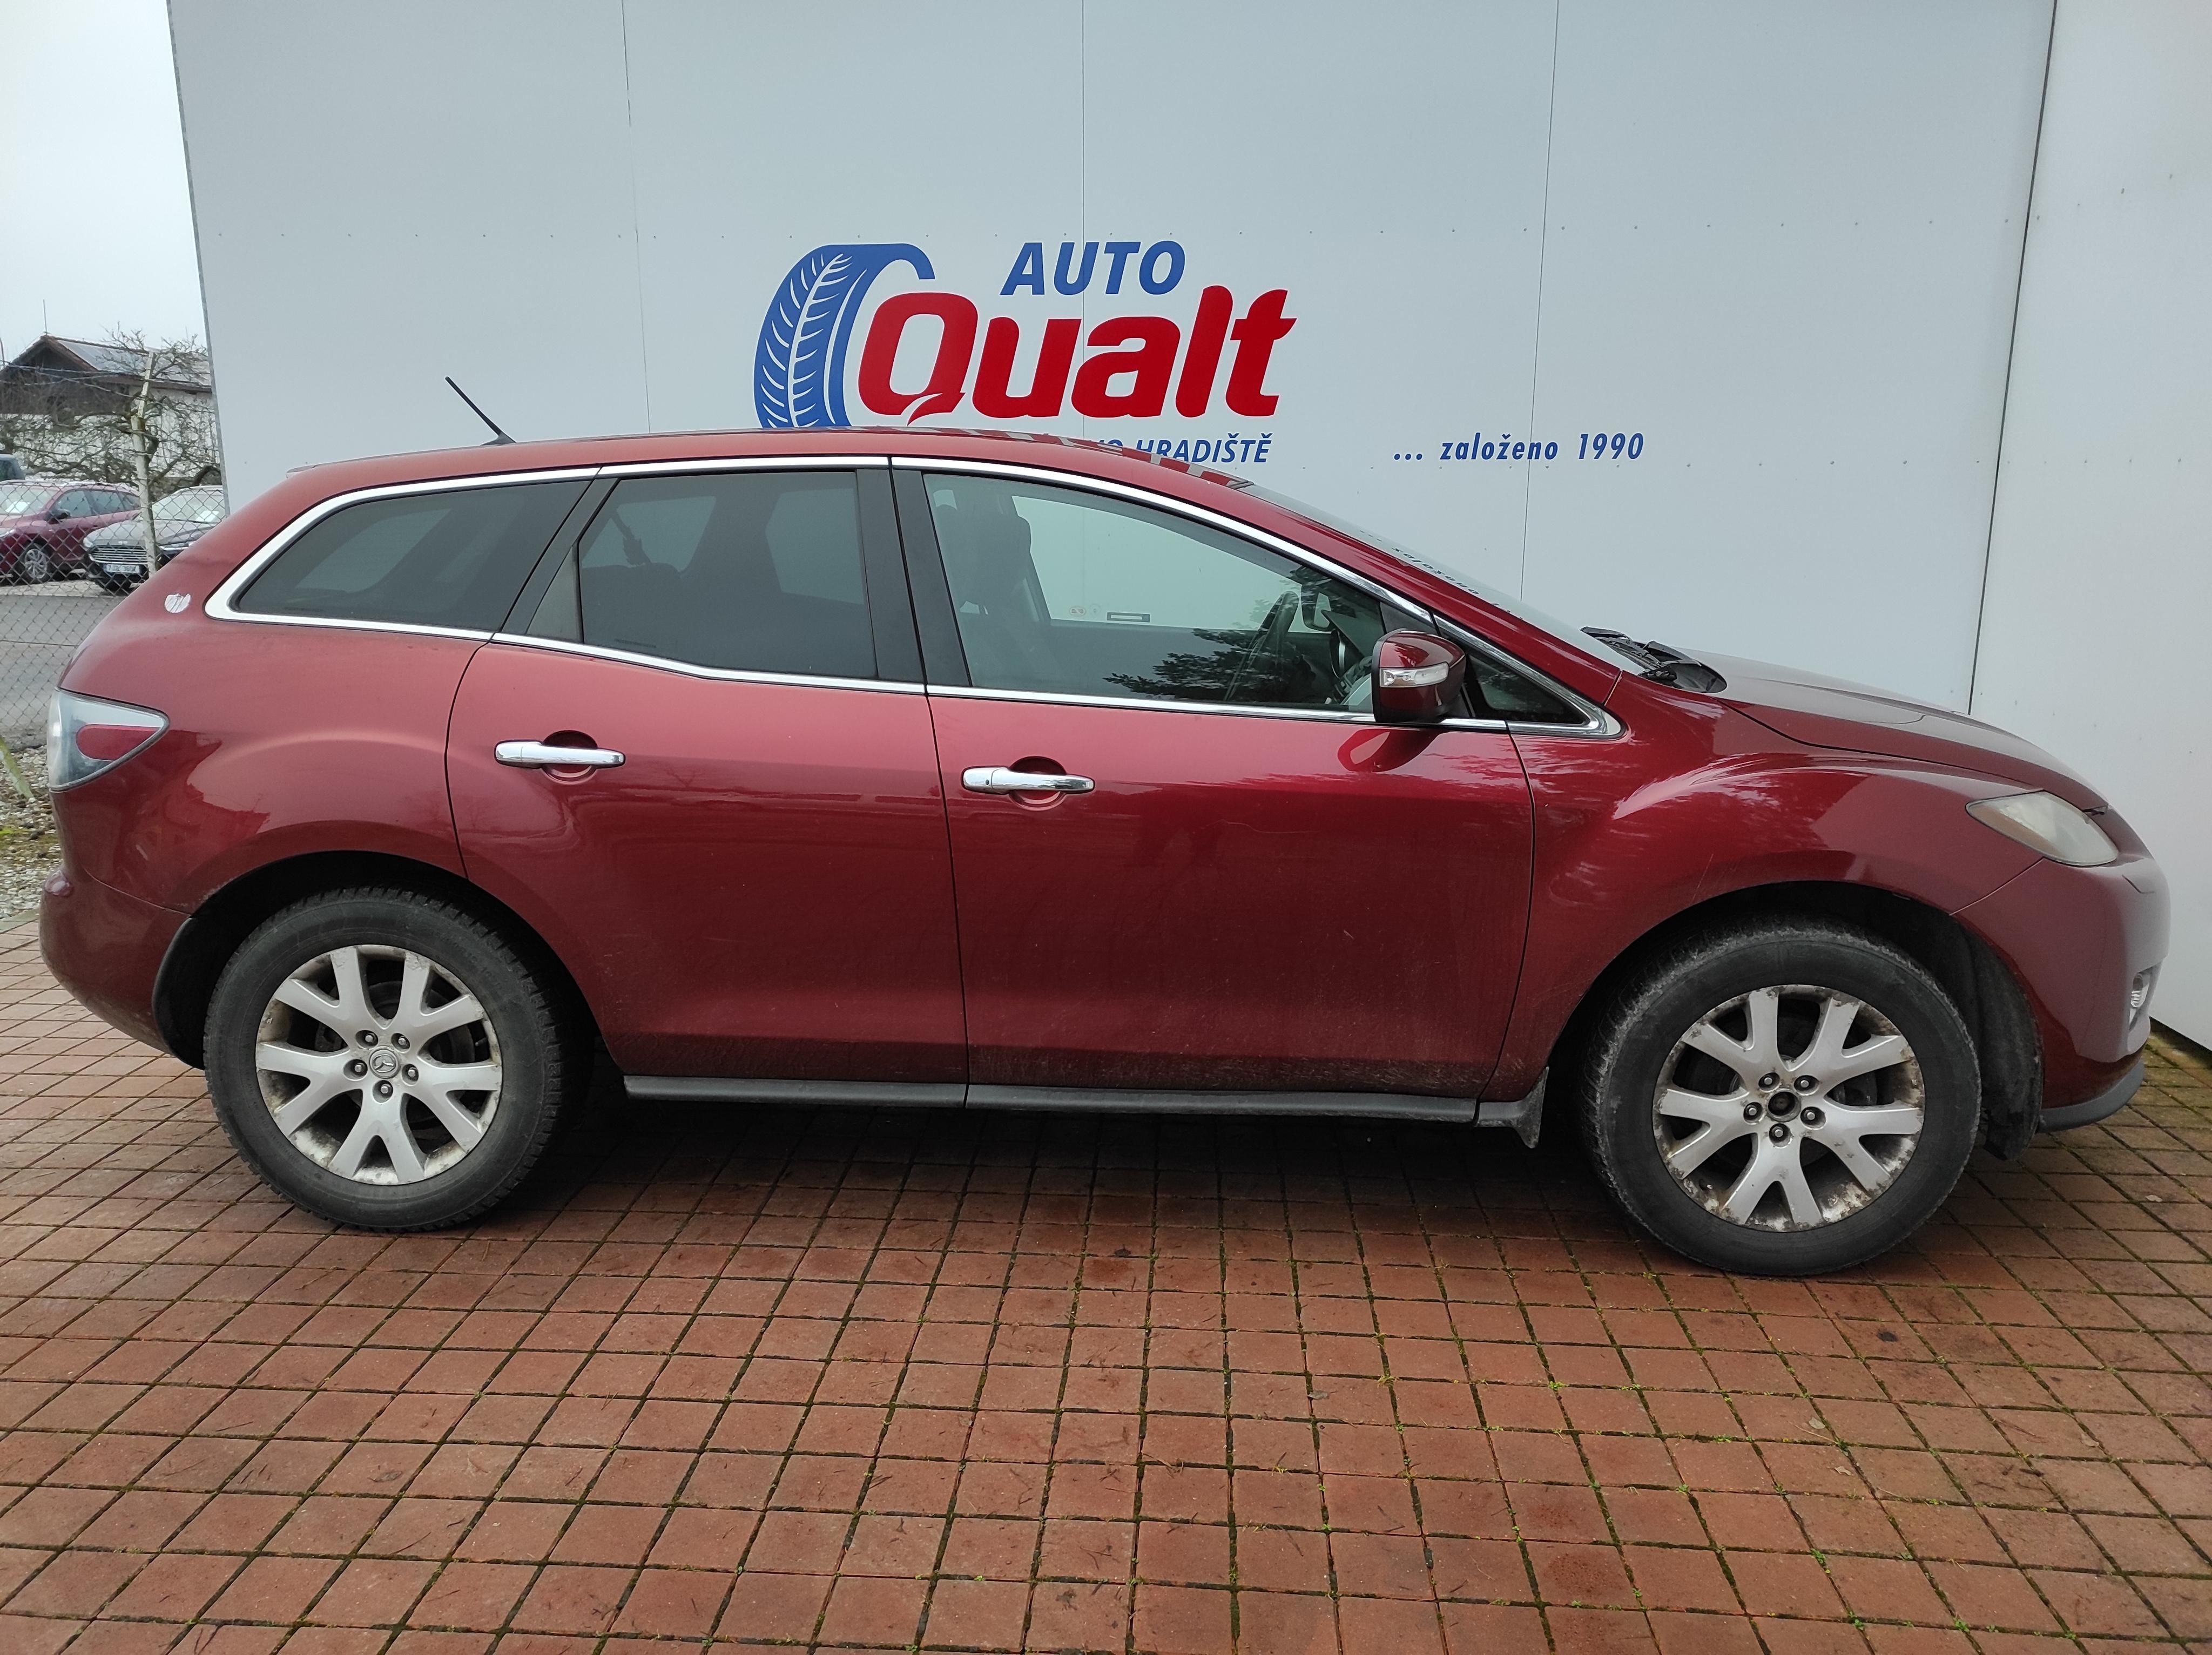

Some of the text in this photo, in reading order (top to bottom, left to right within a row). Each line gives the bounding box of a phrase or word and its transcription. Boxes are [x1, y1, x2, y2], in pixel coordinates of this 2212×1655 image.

[1000, 240, 1187, 296] AUTO
[858, 285, 1297, 427] Qualt
[1440, 432, 1560, 461] založeno
[1579, 433, 1645, 460] 1990
